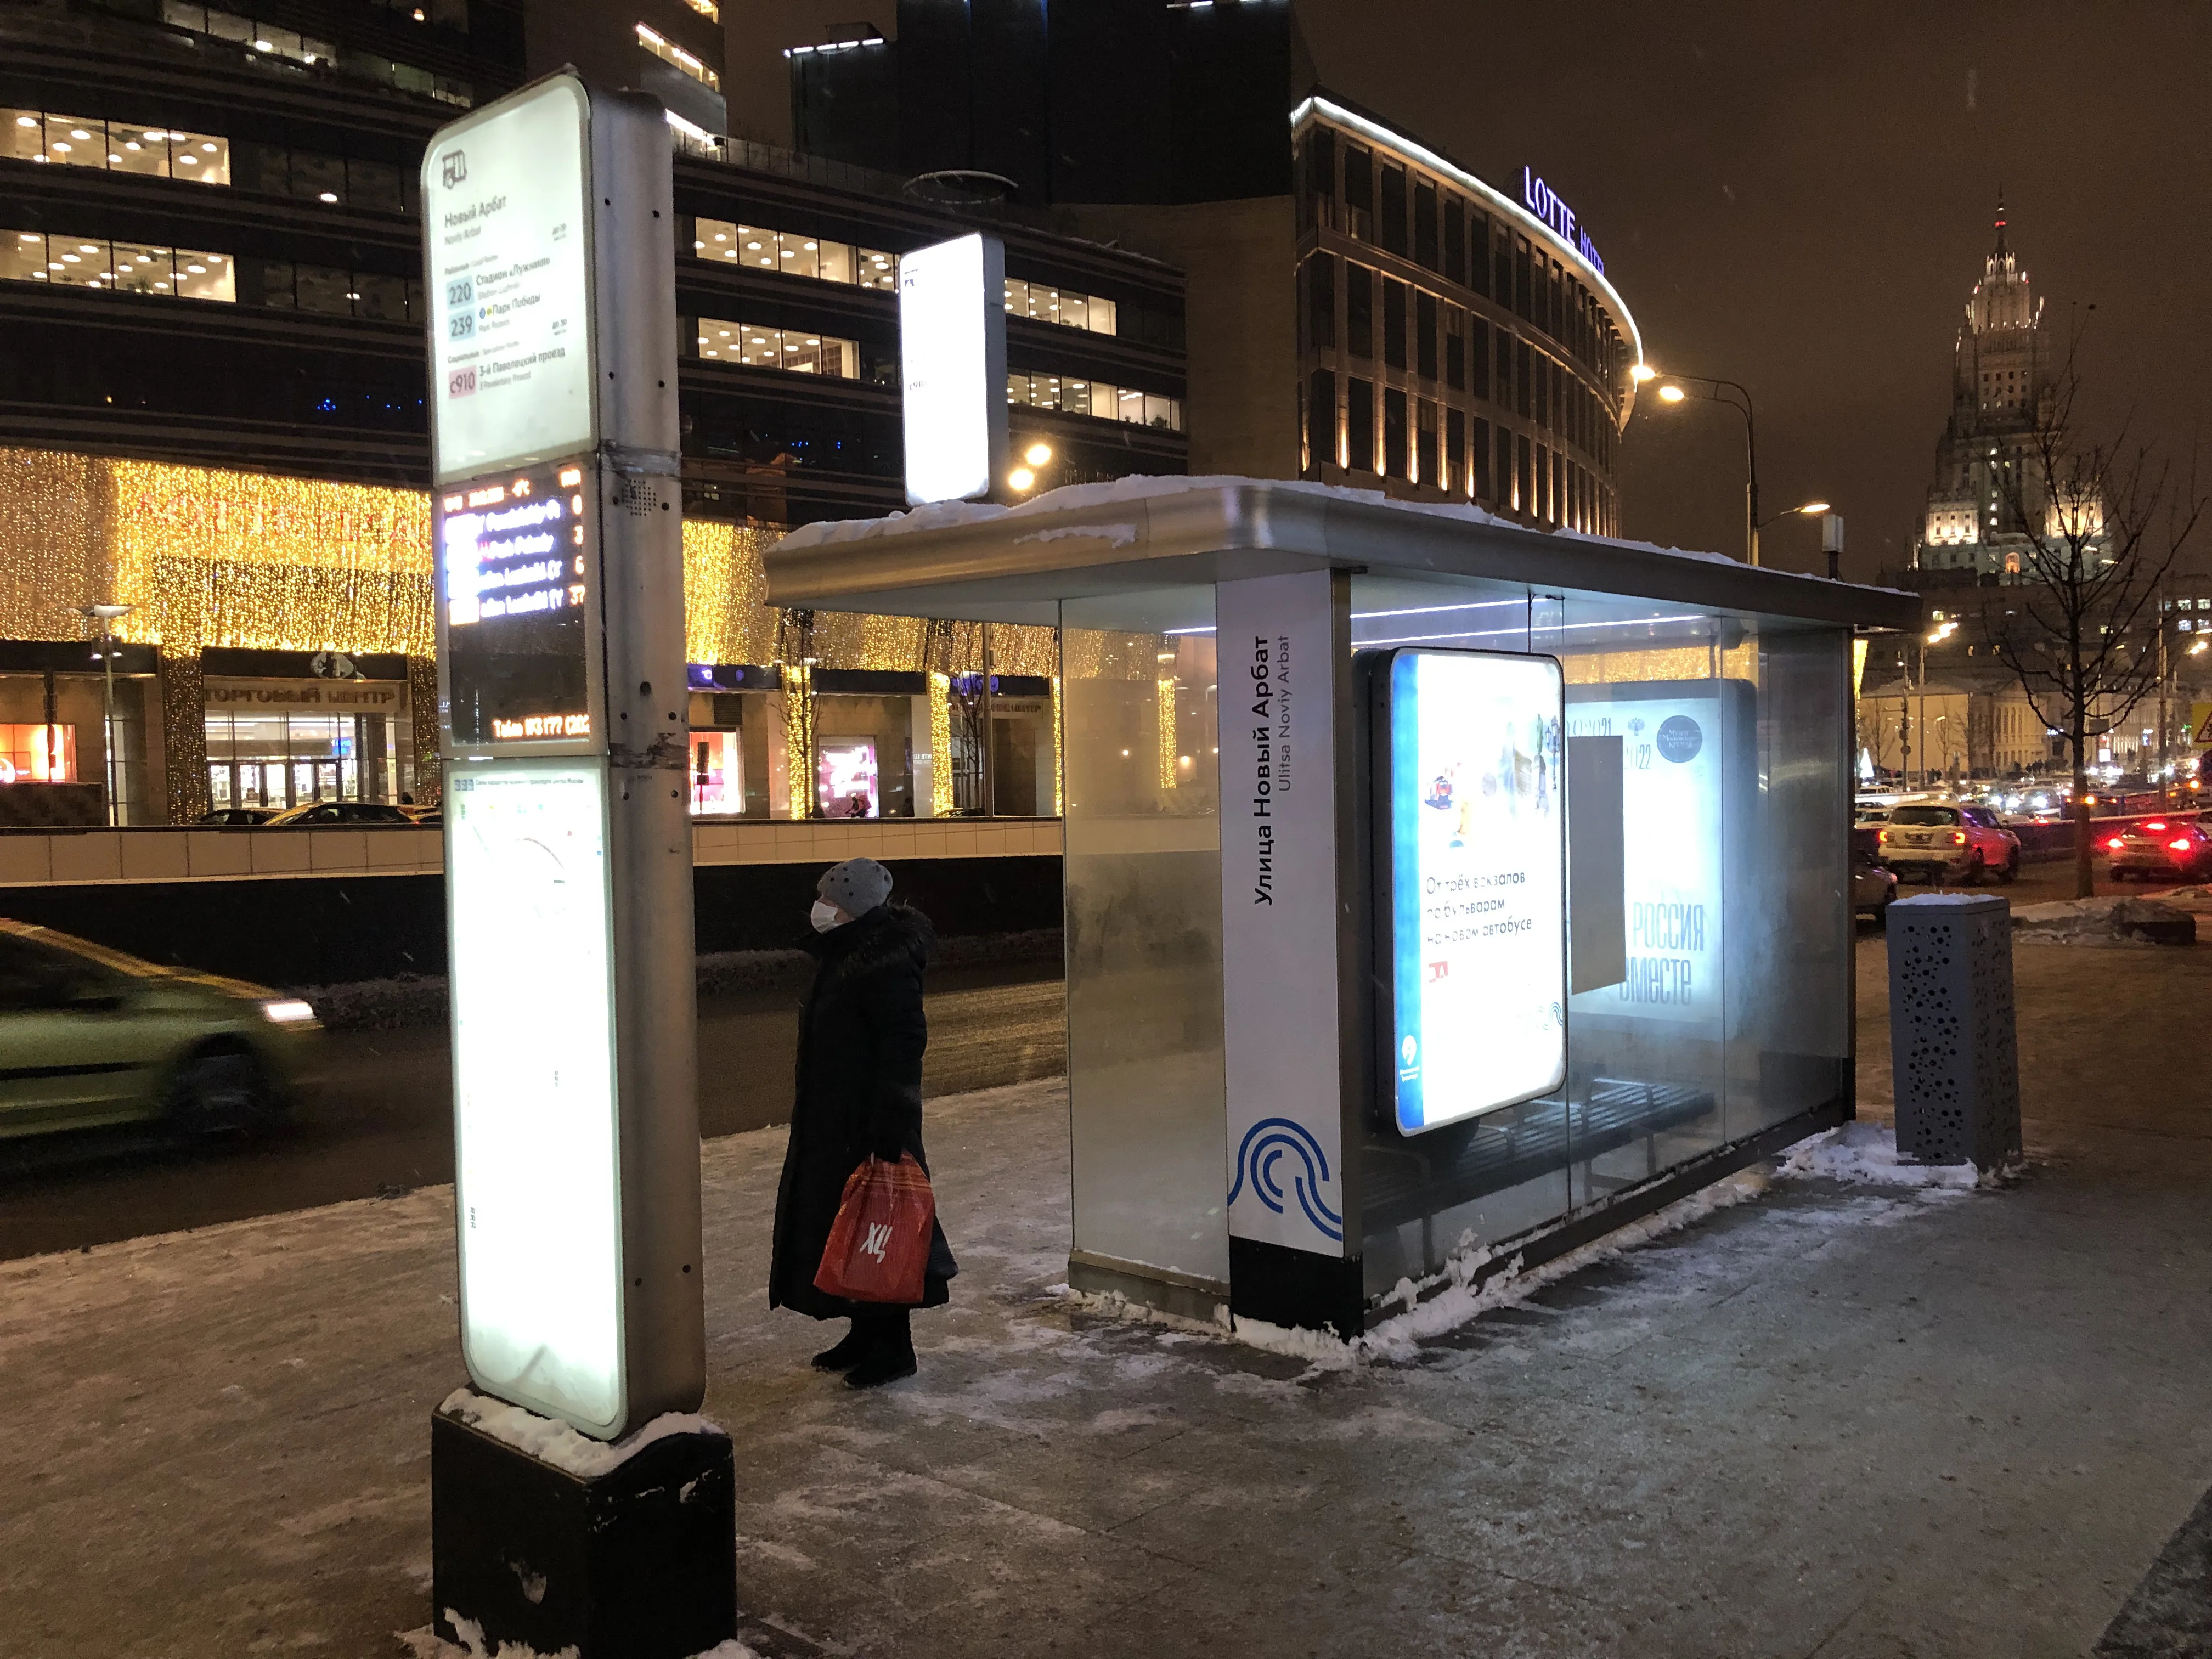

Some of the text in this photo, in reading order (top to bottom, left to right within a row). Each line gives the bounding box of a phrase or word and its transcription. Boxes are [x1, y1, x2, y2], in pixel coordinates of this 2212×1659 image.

[445, 195, 506, 228] Новый Арбат
[1525, 165, 1575, 247] LOTTE
[476, 270, 507, 285] Стадион
[449, 281, 472, 305] 220
[493, 304, 511, 315] Парк
[450, 315, 473, 337] 239
[538, 347, 566, 364] проезд
[1277, 635, 1293, 792] Ulitsa Noviy Arbat
[1250, 635, 1274, 905] Улица Новый Арбат
[1426, 872, 1526, 895] От трёх вокзалов
[1483, 915, 1532, 938] автобусе
[1633, 902, 1704, 951] РОССИЯ
